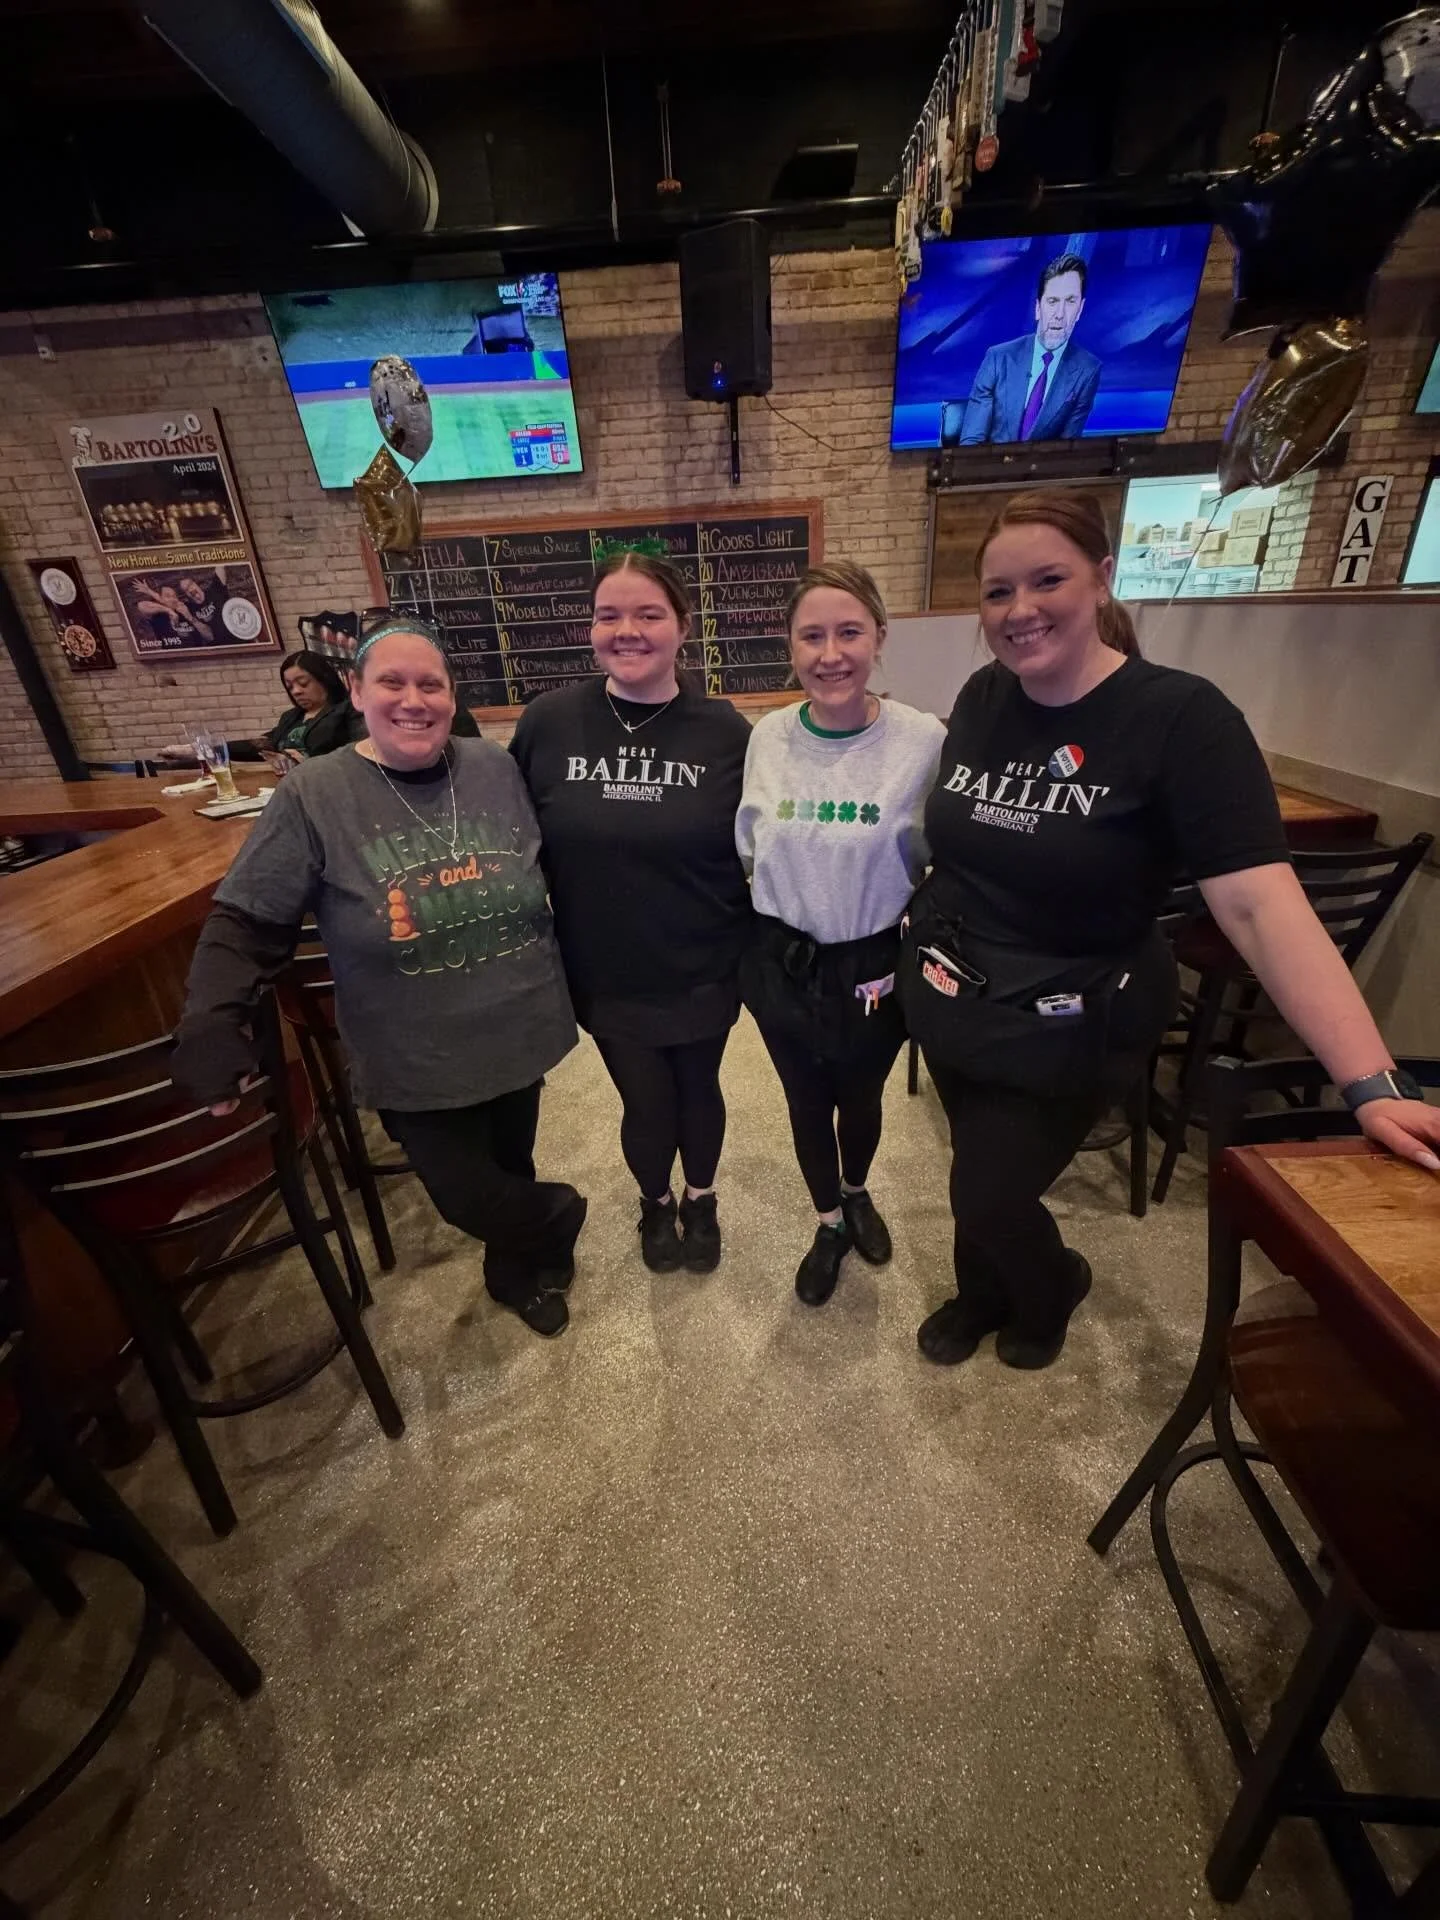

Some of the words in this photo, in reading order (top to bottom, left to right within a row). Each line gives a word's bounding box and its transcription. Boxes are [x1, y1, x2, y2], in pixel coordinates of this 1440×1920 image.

[95, 432, 217, 461] BARTOLINI'S
[172, 462, 197, 475] April
[197, 461, 217, 472] 2024
[700, 531, 709, 552] 19
[709, 527, 754, 551] COORS
[757, 525, 794, 547] LIGHT
[107, 556, 129, 568] New
[194, 547, 246, 561] Traditions
[489, 541, 500, 563] 7
[701, 562, 713, 582] 20
[717, 556, 798, 581] AMBIGRAM
[388, 575, 399, 597] 2
[493, 570, 504, 593] 8
[703, 591, 714, 612] 21
[719, 583, 784, 600] YUENGLING
[496, 602, 506, 622] 9
[506, 602, 550, 621] MODELO
[550, 597, 592, 617] ESPECIA
[727, 610, 787, 625] PIPEWORK
[500, 631, 510, 651] 10
[564, 624, 592, 643] WHIT
[705, 618, 718, 640] 22
[139, 639, 162, 648] Since
[163, 637, 182, 647] 1995
[456, 634, 488, 650] LITE
[706, 646, 722, 667] 23
[509, 686, 521, 704] 12
[708, 674, 722, 695] 24
[618, 746, 656, 758] MEAT
[1060, 751, 1074, 772] VOTED
[565, 756, 706, 788] BALLIN'
[1005, 761, 1046, 777] MEAT
[603, 783, 664, 795] BARTOLINI'S
[944, 764, 1110, 816] BALLIN'
[974, 802, 1040, 825] BARTOLINI'S
[439, 856, 482, 887] and
